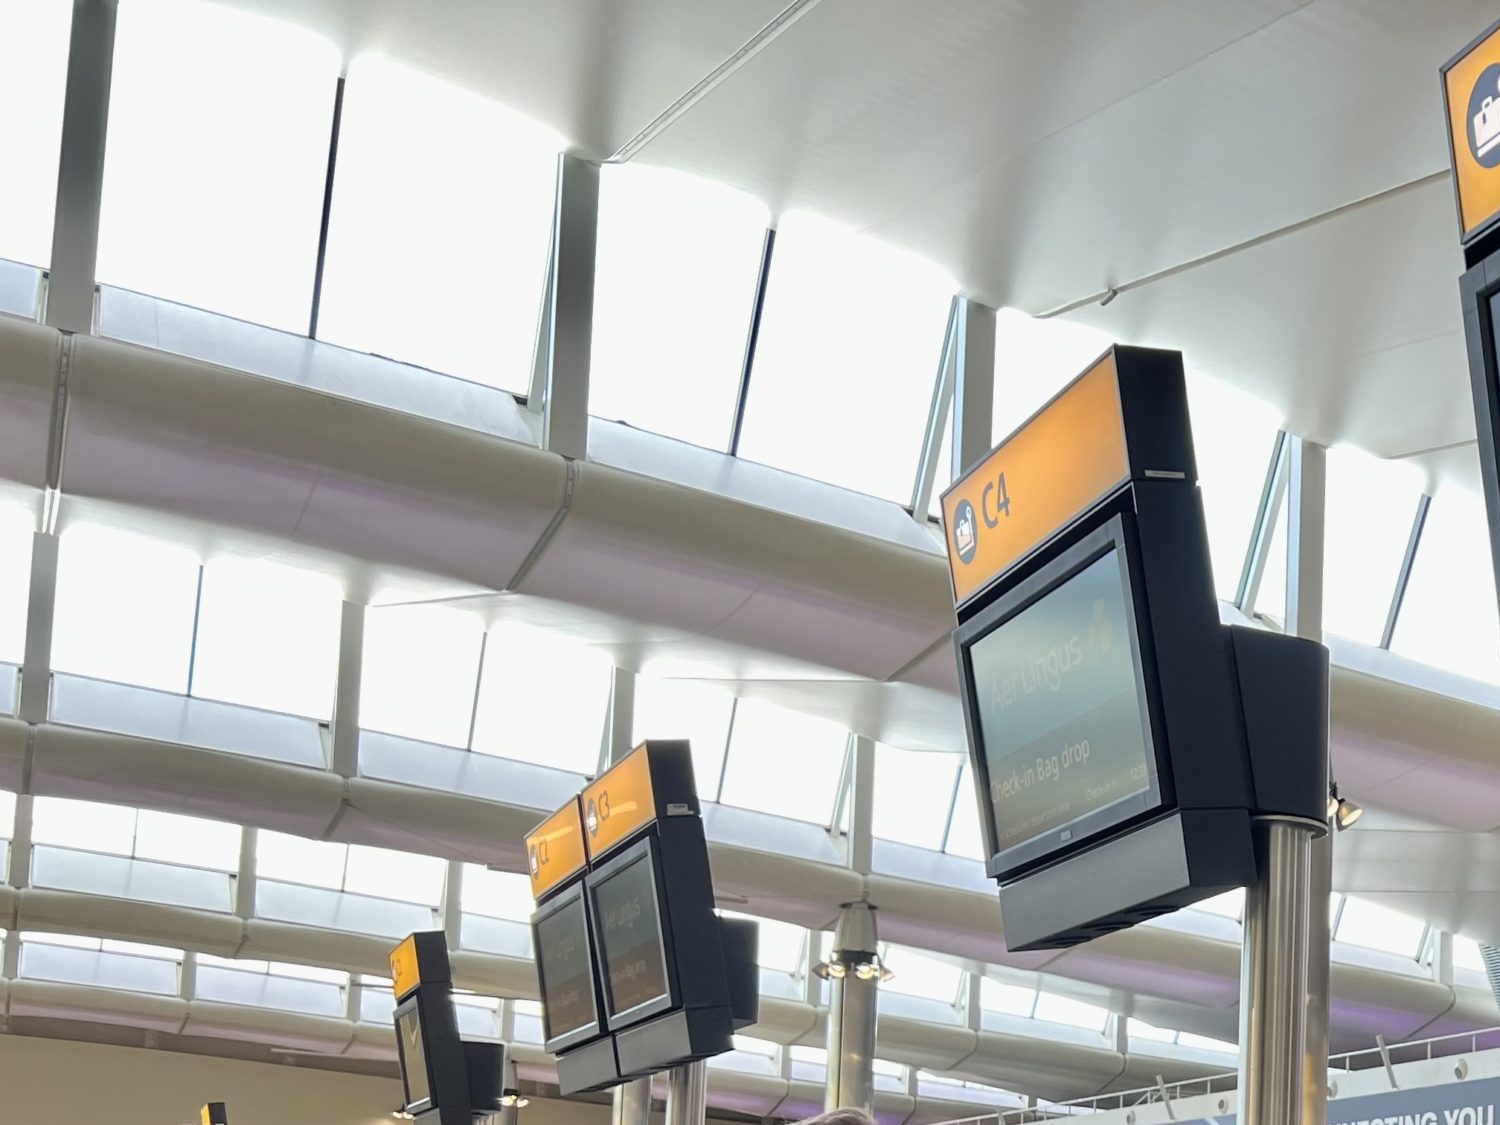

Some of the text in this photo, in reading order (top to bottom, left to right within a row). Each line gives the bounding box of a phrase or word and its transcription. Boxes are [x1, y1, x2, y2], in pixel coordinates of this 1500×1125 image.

[982, 472, 1010, 529] C4
[1036, 757, 1060, 781] Bag
[1061, 739, 1091, 769] drop
[598, 790, 610, 821] C3
